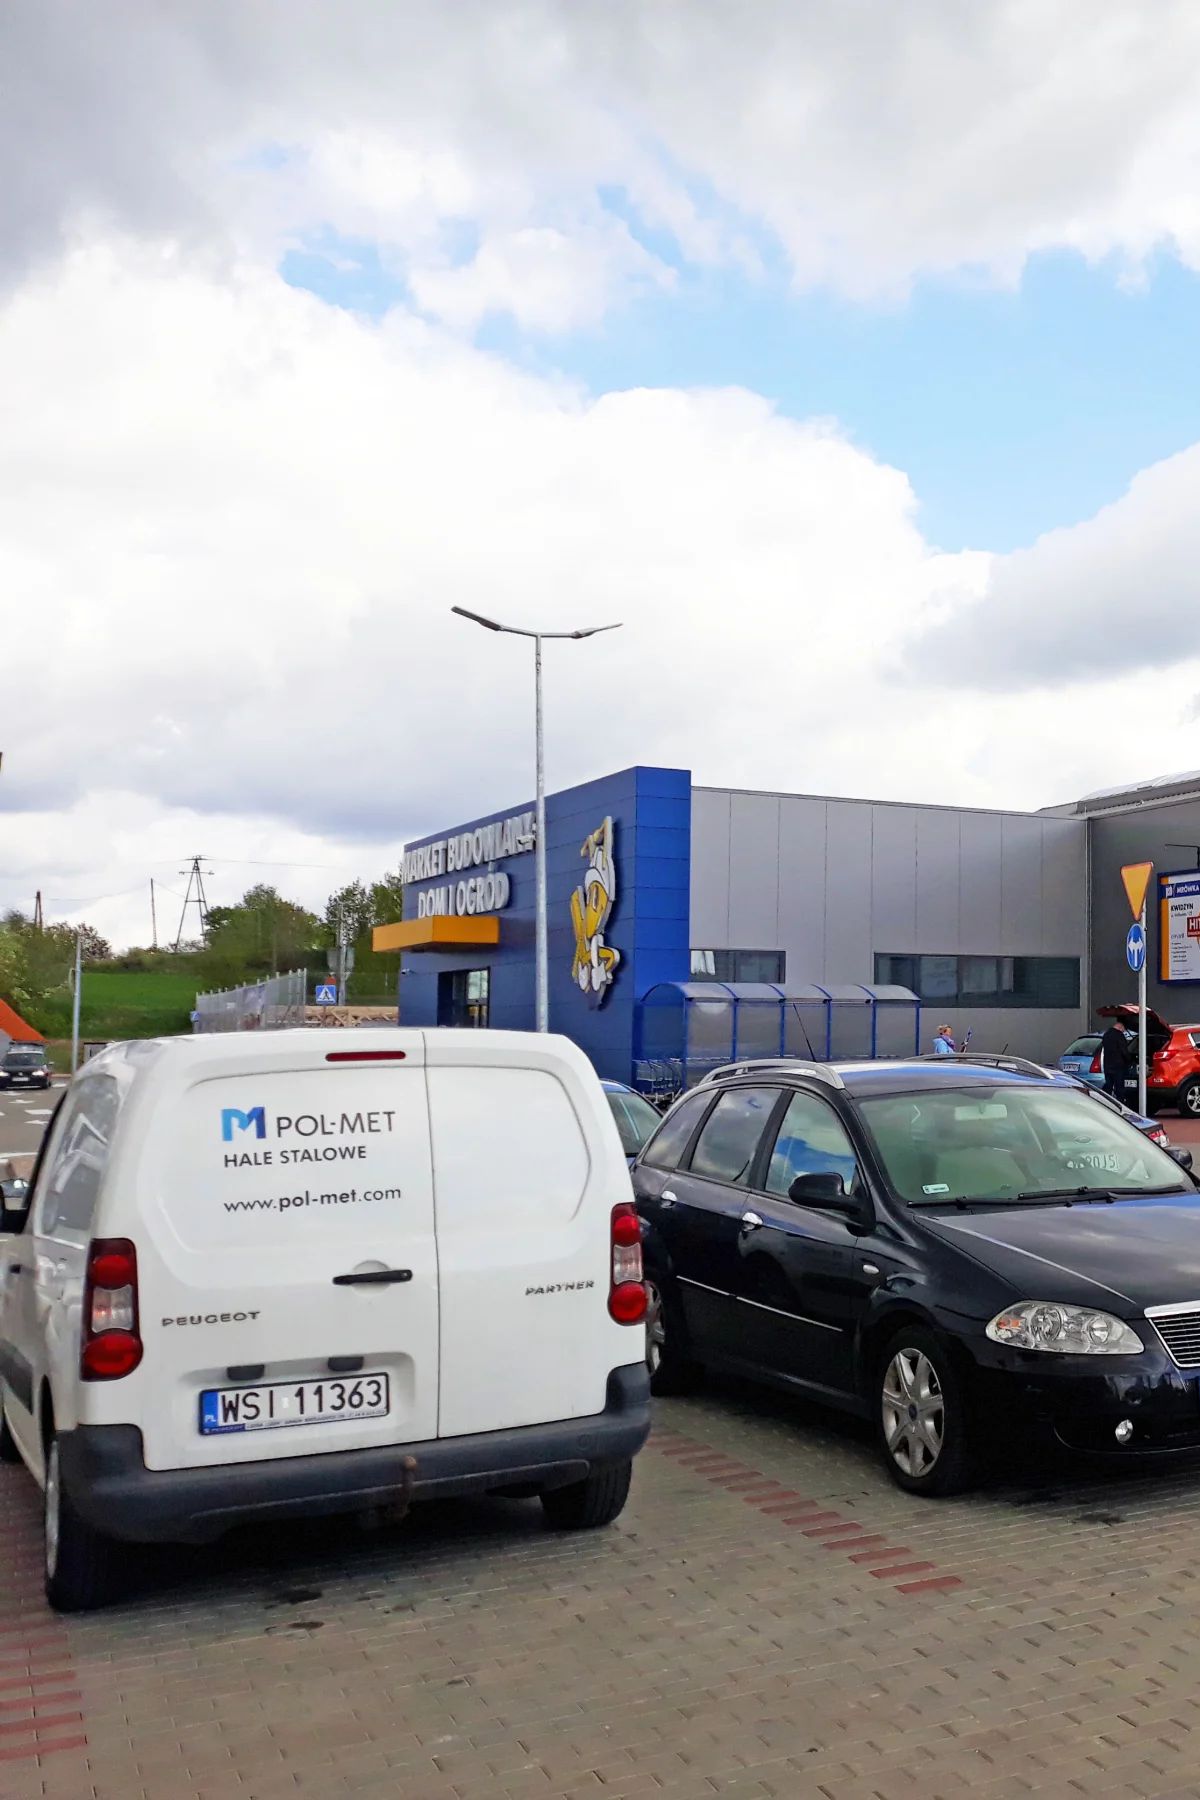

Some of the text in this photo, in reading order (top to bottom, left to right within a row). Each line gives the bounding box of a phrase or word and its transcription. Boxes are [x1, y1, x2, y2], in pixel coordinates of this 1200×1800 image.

[401, 841, 447, 884] MARKET
[418, 886, 446, 918] DOM
[456, 862, 510, 916] OGRÓD
[1171, 902, 1194, 912] KWIDZYN
[276, 1111, 396, 1138] POL-MET
[224, 1146, 367, 1168] HALE STALOWE
[224, 1188, 402, 1212] www.pol-met.com
[525, 1280, 595, 1296] PARTNER
[161, 1310, 261, 1327] PEUGEOT
[221, 1389, 275, 1423] WSI
[294, 1380, 382, 1415] 11363
[204, 1414, 217, 1423] PL
